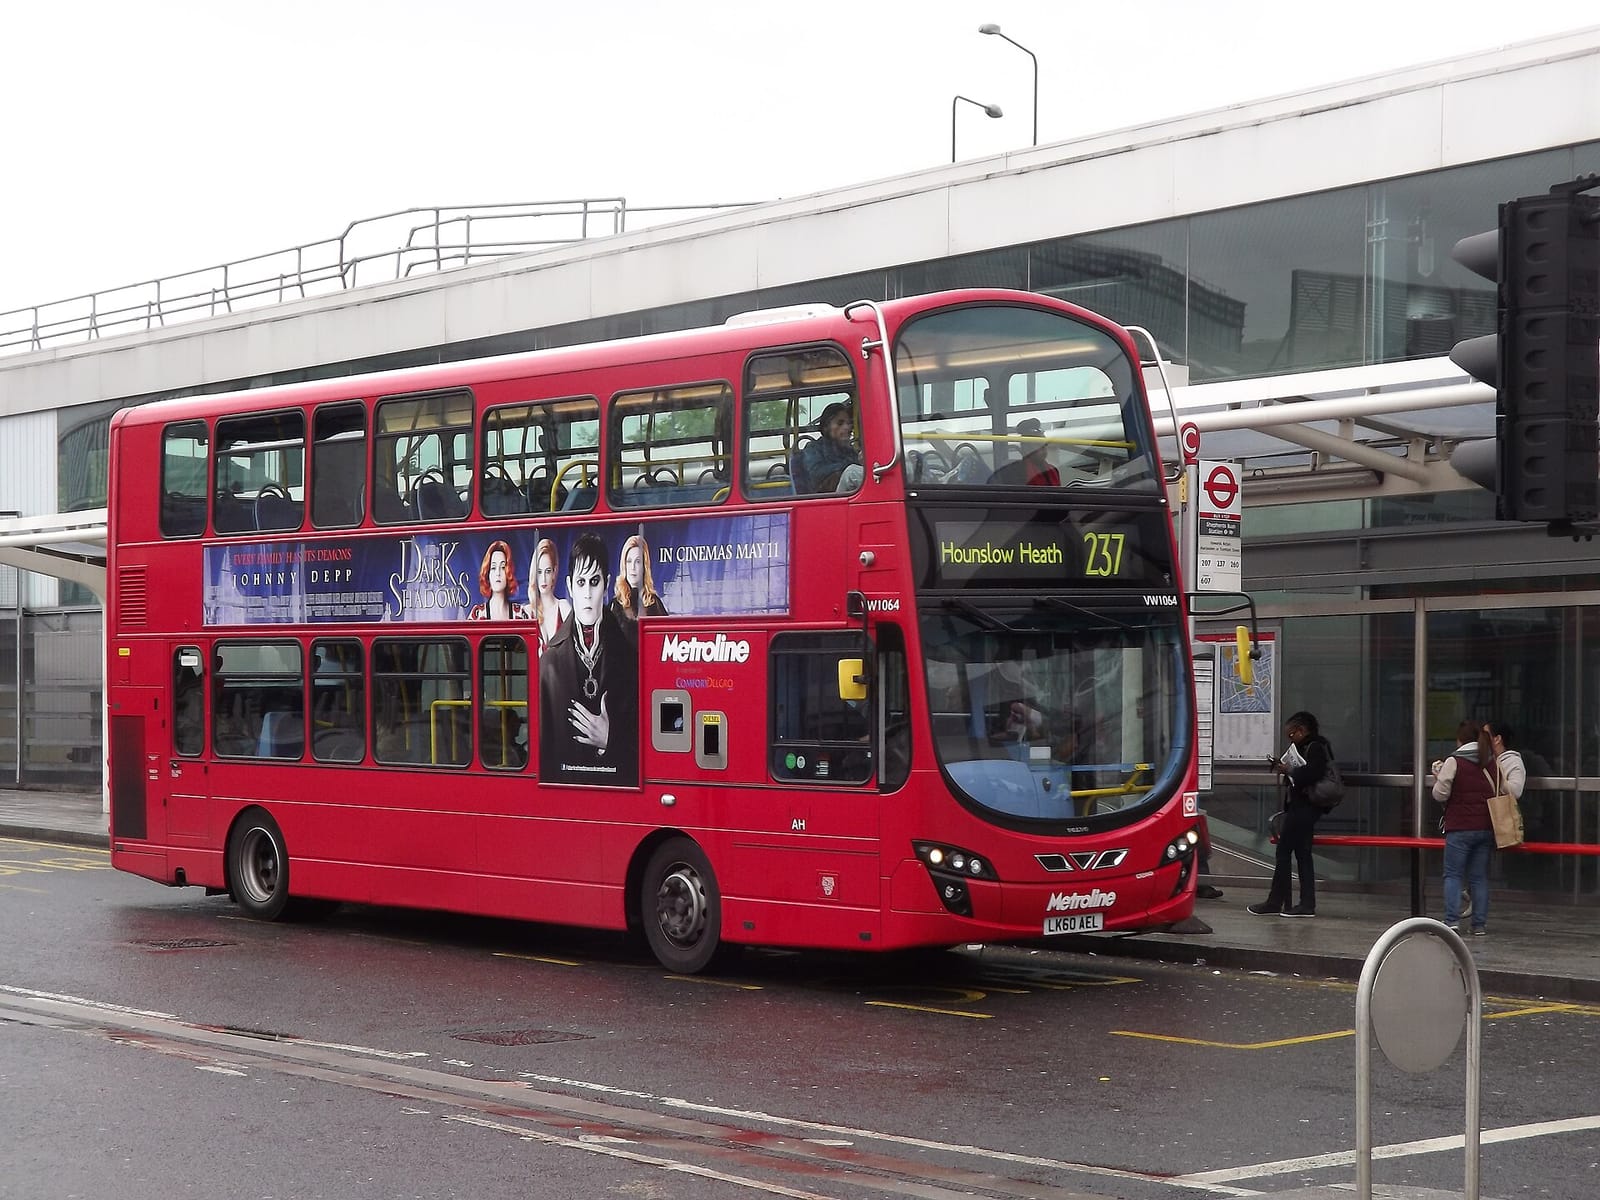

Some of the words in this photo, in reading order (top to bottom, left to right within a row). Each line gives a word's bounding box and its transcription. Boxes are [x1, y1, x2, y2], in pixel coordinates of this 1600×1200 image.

[1183, 428, 1197, 454] C
[257, 551, 283, 565] FAMILY
[304, 549, 316, 562] ITS
[318, 548, 352, 561] DEMONS
[399, 540, 459, 586] DARK
[659, 547, 673, 564] IN
[676, 544, 733, 563] CINEMAS
[736, 543, 765, 560] MAY
[767, 542, 779, 558] 11
[941, 541, 1014, 564] Hounslow
[1020, 542, 1064, 564] Heath
[1083, 532, 1125, 577] 237
[232, 572, 297, 588] JOHNNY
[311, 569, 352, 583] DEPP
[389, 572, 471, 617] SHADOWS
[1143, 595, 1178, 607] VW1064
[661, 633, 750, 663] Metroline
[791, 819, 806, 830] AH
[1046, 888, 1117, 912] Metroline
[1048, 917, 1076, 932] LK60
[1079, 915, 1098, 929] AEL
